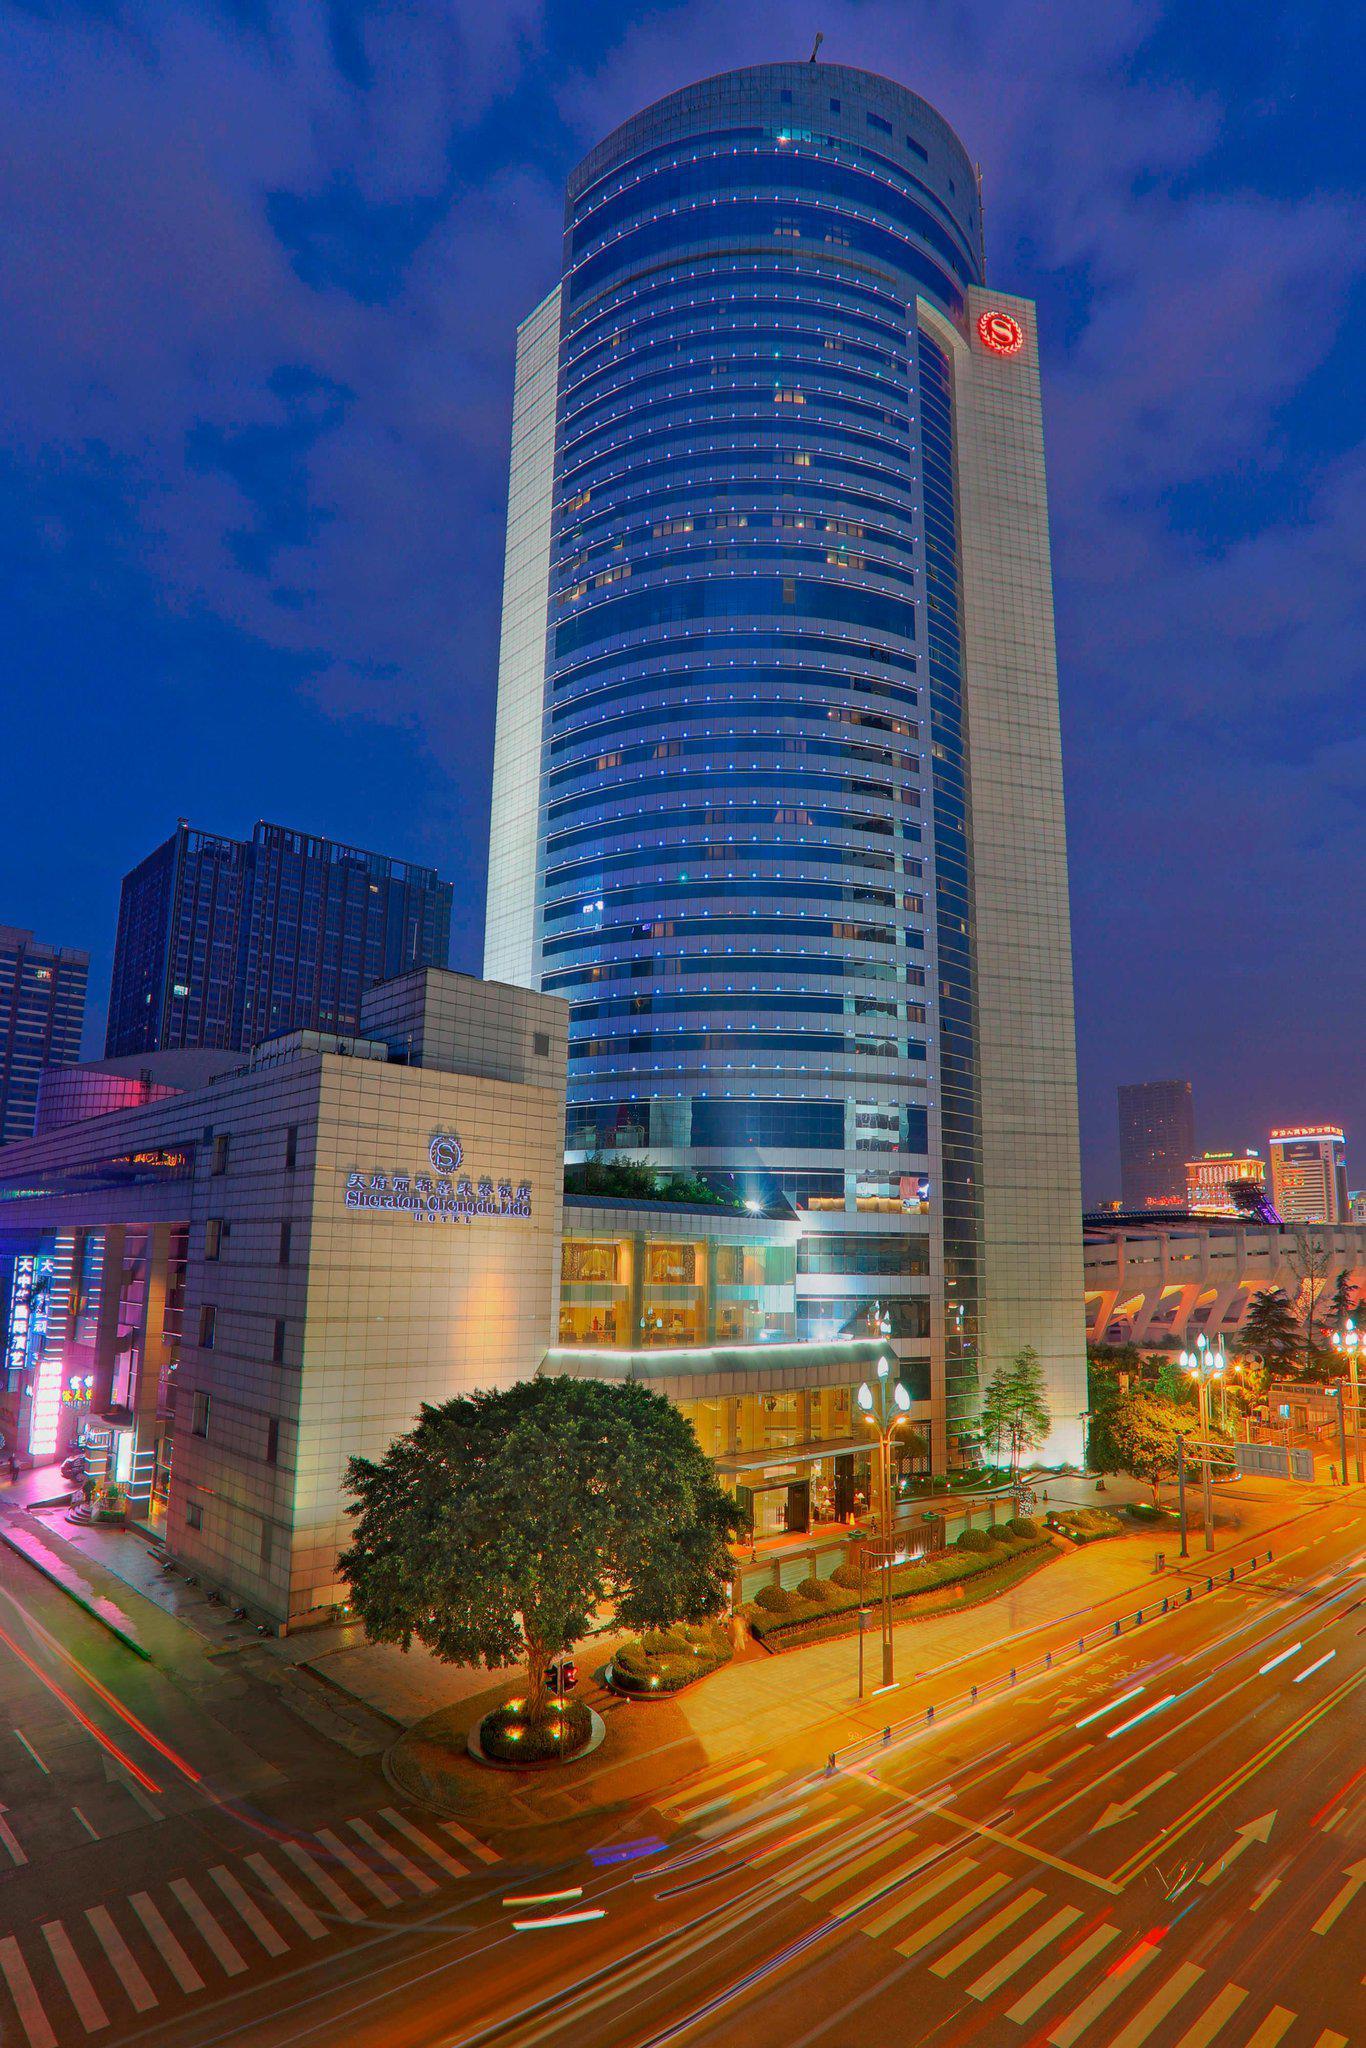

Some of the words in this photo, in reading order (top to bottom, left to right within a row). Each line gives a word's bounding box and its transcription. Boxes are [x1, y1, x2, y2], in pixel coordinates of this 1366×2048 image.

[991, 318, 1013, 343] S
[346, 1190, 424, 1211] Sheraton
[426, 1195, 497, 1217] Chengdu
[499, 1199, 532, 1217] Lido
[414, 1212, 472, 1225] HOTEL
